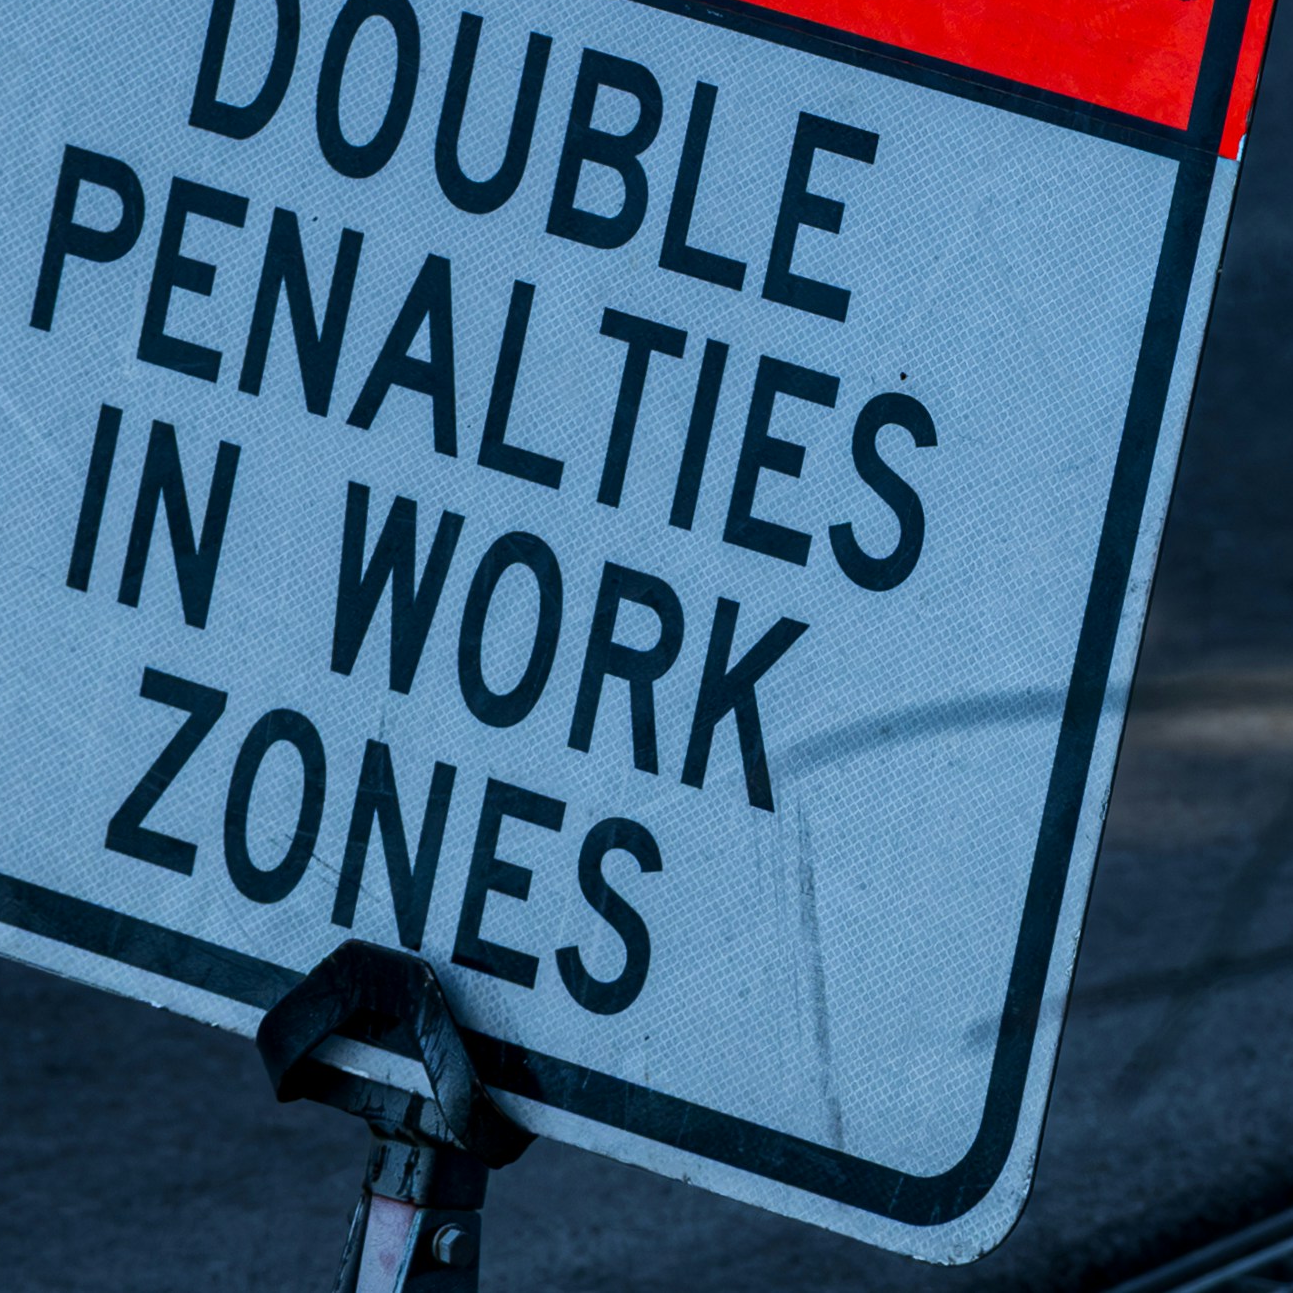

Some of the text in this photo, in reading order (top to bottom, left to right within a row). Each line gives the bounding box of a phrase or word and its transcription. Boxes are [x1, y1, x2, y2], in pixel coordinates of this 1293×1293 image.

[28, 142, 939, 593] PENALTIES
[65, 400, 811, 815] IN WORK
[103, 664, 664, 1017] ZONES
